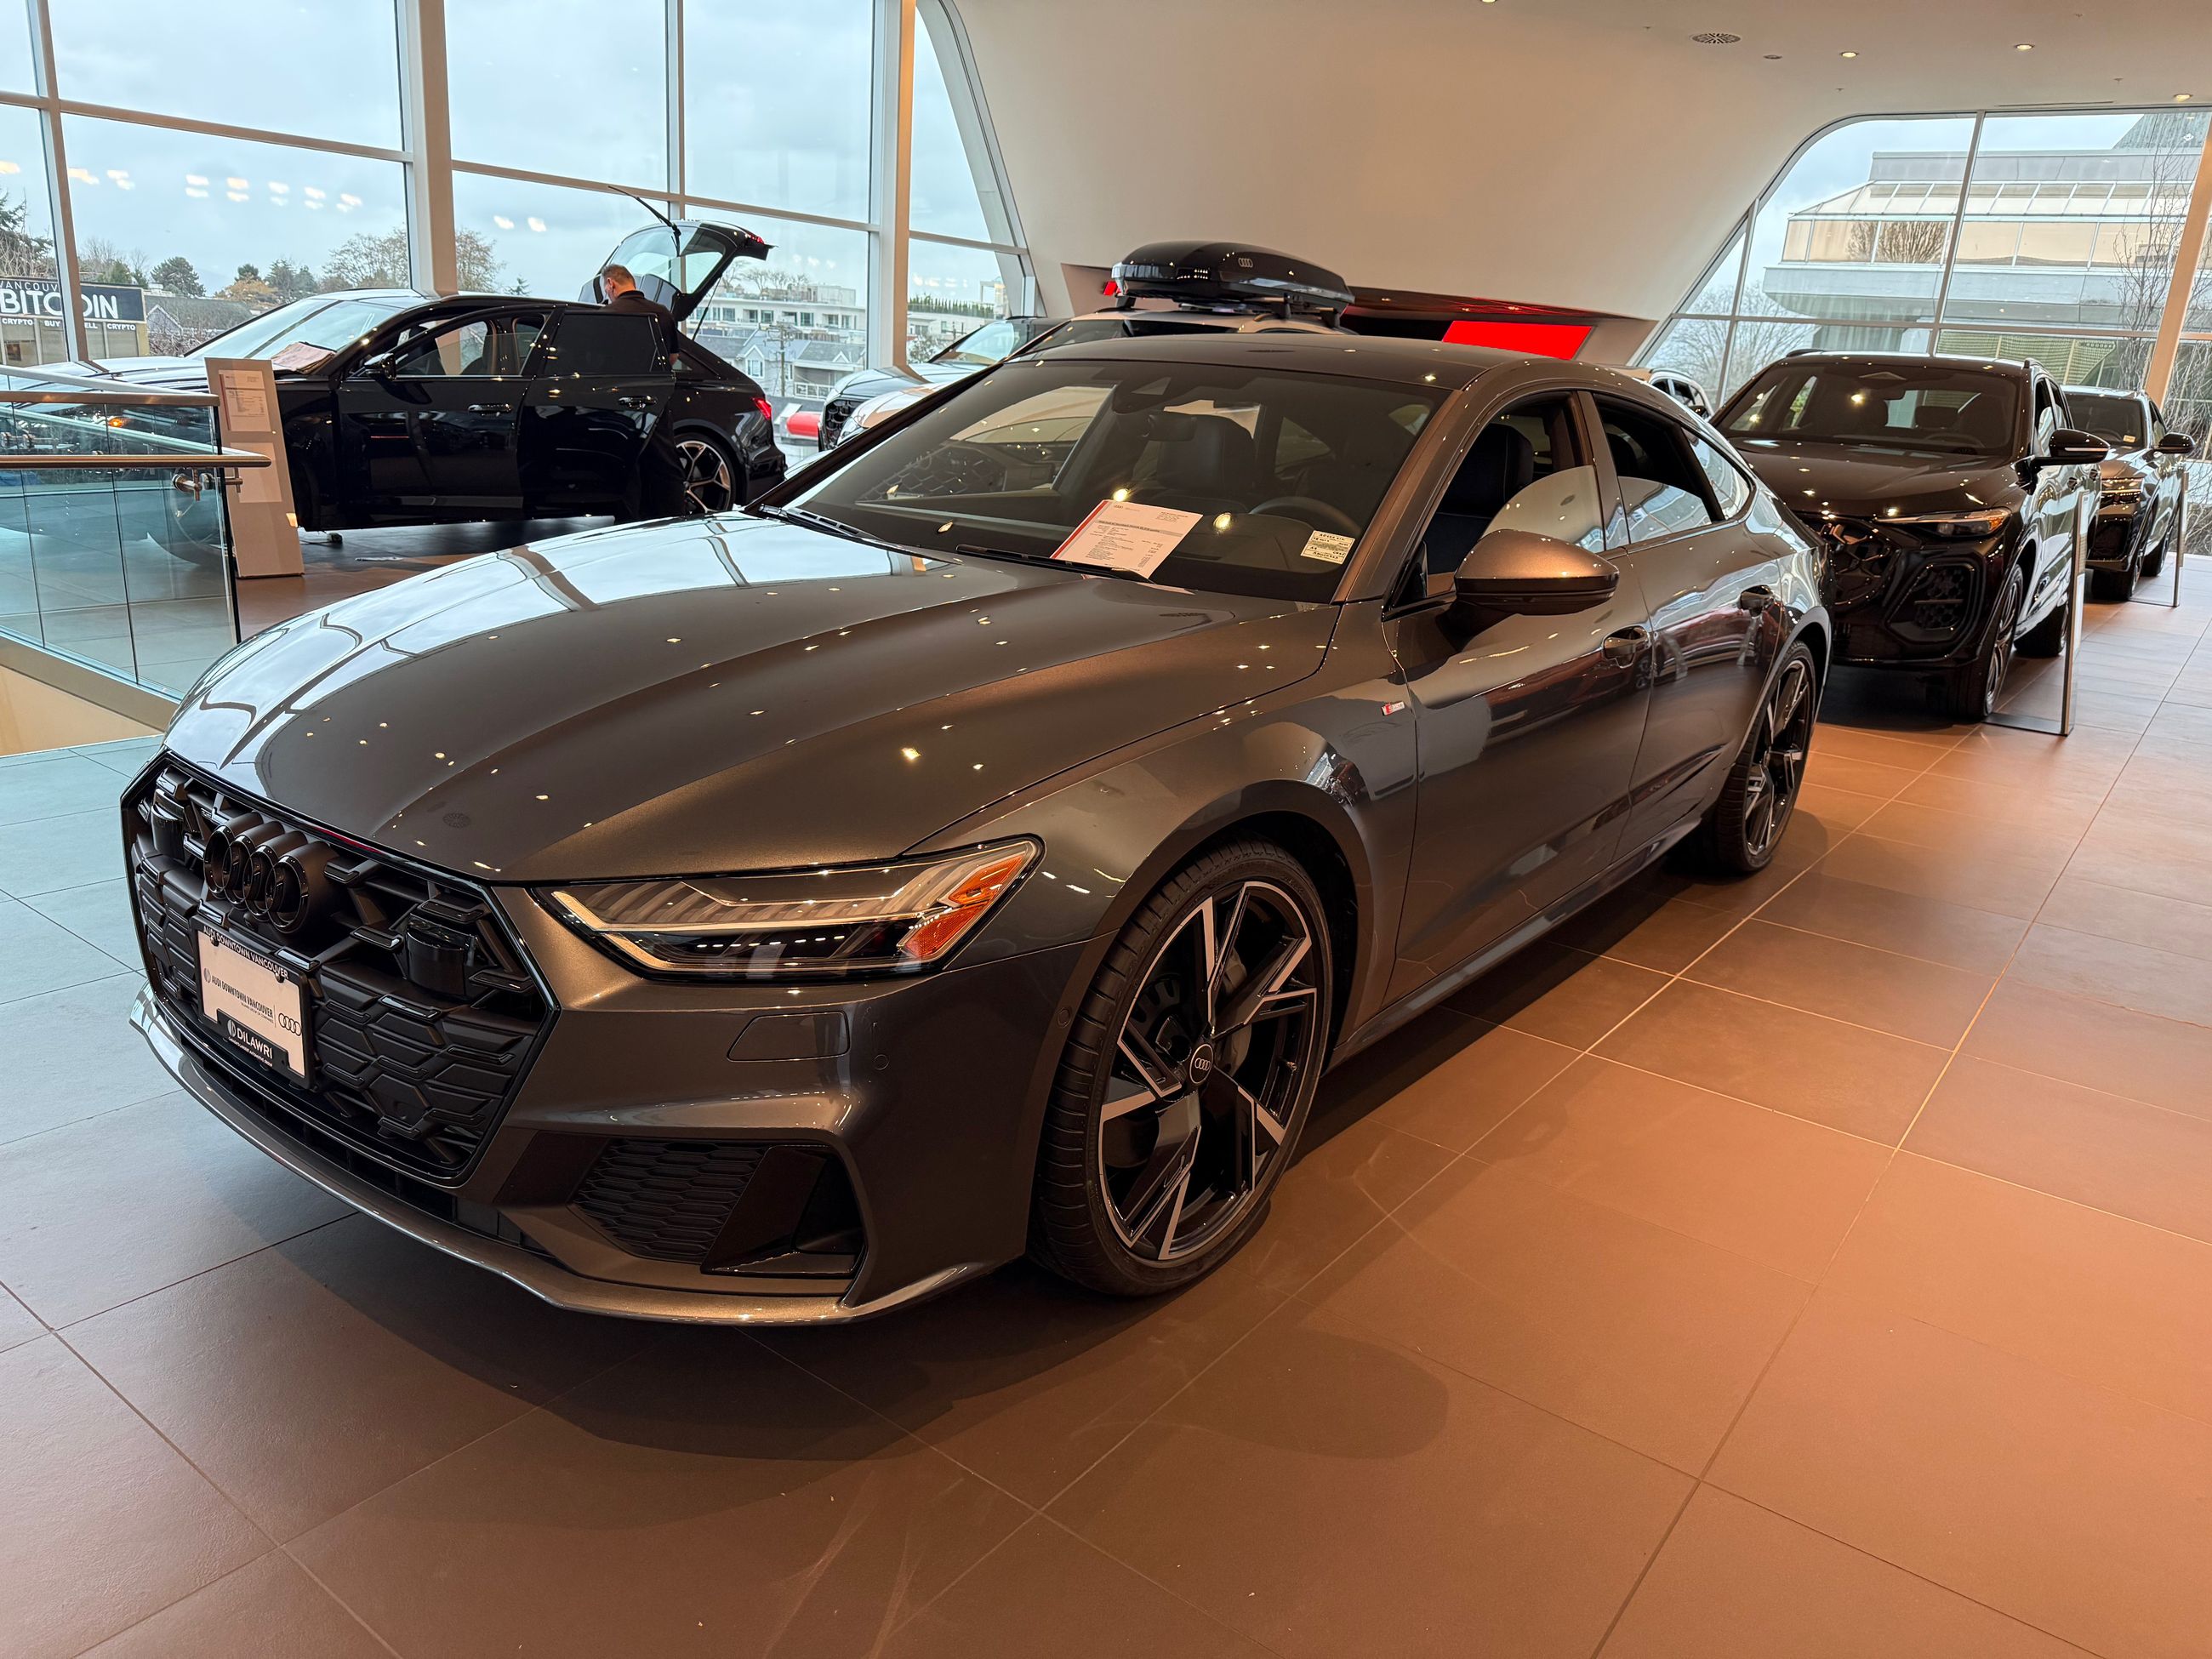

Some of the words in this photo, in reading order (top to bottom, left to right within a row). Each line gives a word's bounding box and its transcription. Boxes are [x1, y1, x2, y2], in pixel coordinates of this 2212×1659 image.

[0, 280, 58, 292] VANCOUV
[2, 317, 33, 326] CRYPTO
[203, 925, 217, 940] AUDI
[216, 932, 250, 959] DOWNTOWN
[250, 951, 289, 979] VANCOUVER
[211, 975, 222, 989] AUDI
[221, 980, 247, 1004] DOWNTOWN
[246, 995, 273, 1018] VANCOUVER
[237, 1027, 272, 1059] DILAWRI
